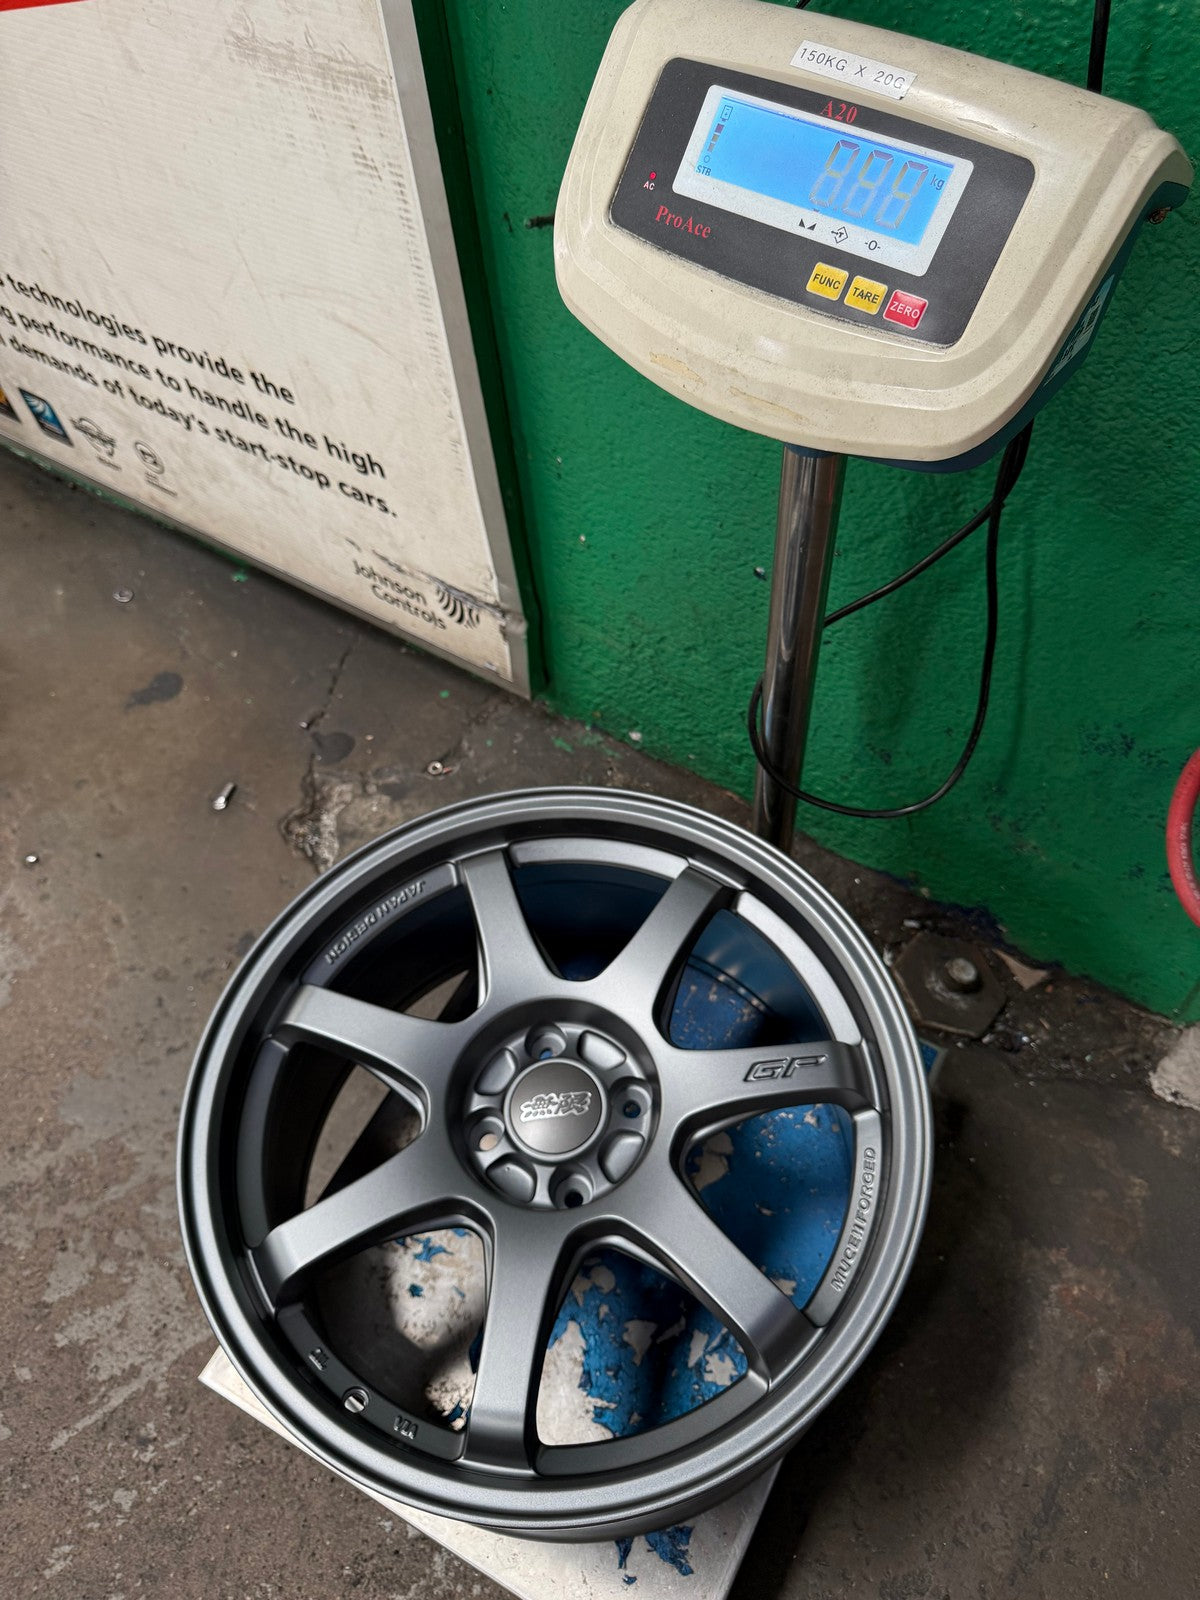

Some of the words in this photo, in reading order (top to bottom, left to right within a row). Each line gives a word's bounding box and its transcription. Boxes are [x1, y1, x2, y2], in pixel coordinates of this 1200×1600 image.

[800, 47, 848, 72] 150KG
[854, 64, 868, 78] X
[874, 70, 906, 90] 20G
[820, 100, 858, 124] A20
[643, 180, 656, 191] AC
[695, 164, 712, 177] STB
[930, 174, 946, 191] kg
[655, 204, 712, 239] ProAce
[812, 273, 841, 290] FUNC
[852, 287, 880, 304] TARE
[890, 301, 920, 319] ZERO
[6, 274, 147, 345] technologies
[152, 335, 245, 386] provide
[250, 371, 295, 405] the
[17, 312, 152, 380] performance
[155, 368, 182, 393] to
[184, 378, 270, 430] handle
[275, 417, 319, 450] the
[323, 435, 387, 480] high
[9, 335, 99, 387] demands
[103, 379, 125, 399] of
[128, 385, 210, 435] today's
[214, 427, 331, 490] start-stop
[338, 481, 399, 518] cars.
[352, 559, 428, 606] Johnson
[371, 584, 447, 631] Controls
[375, 879, 427, 918] JAPAN
